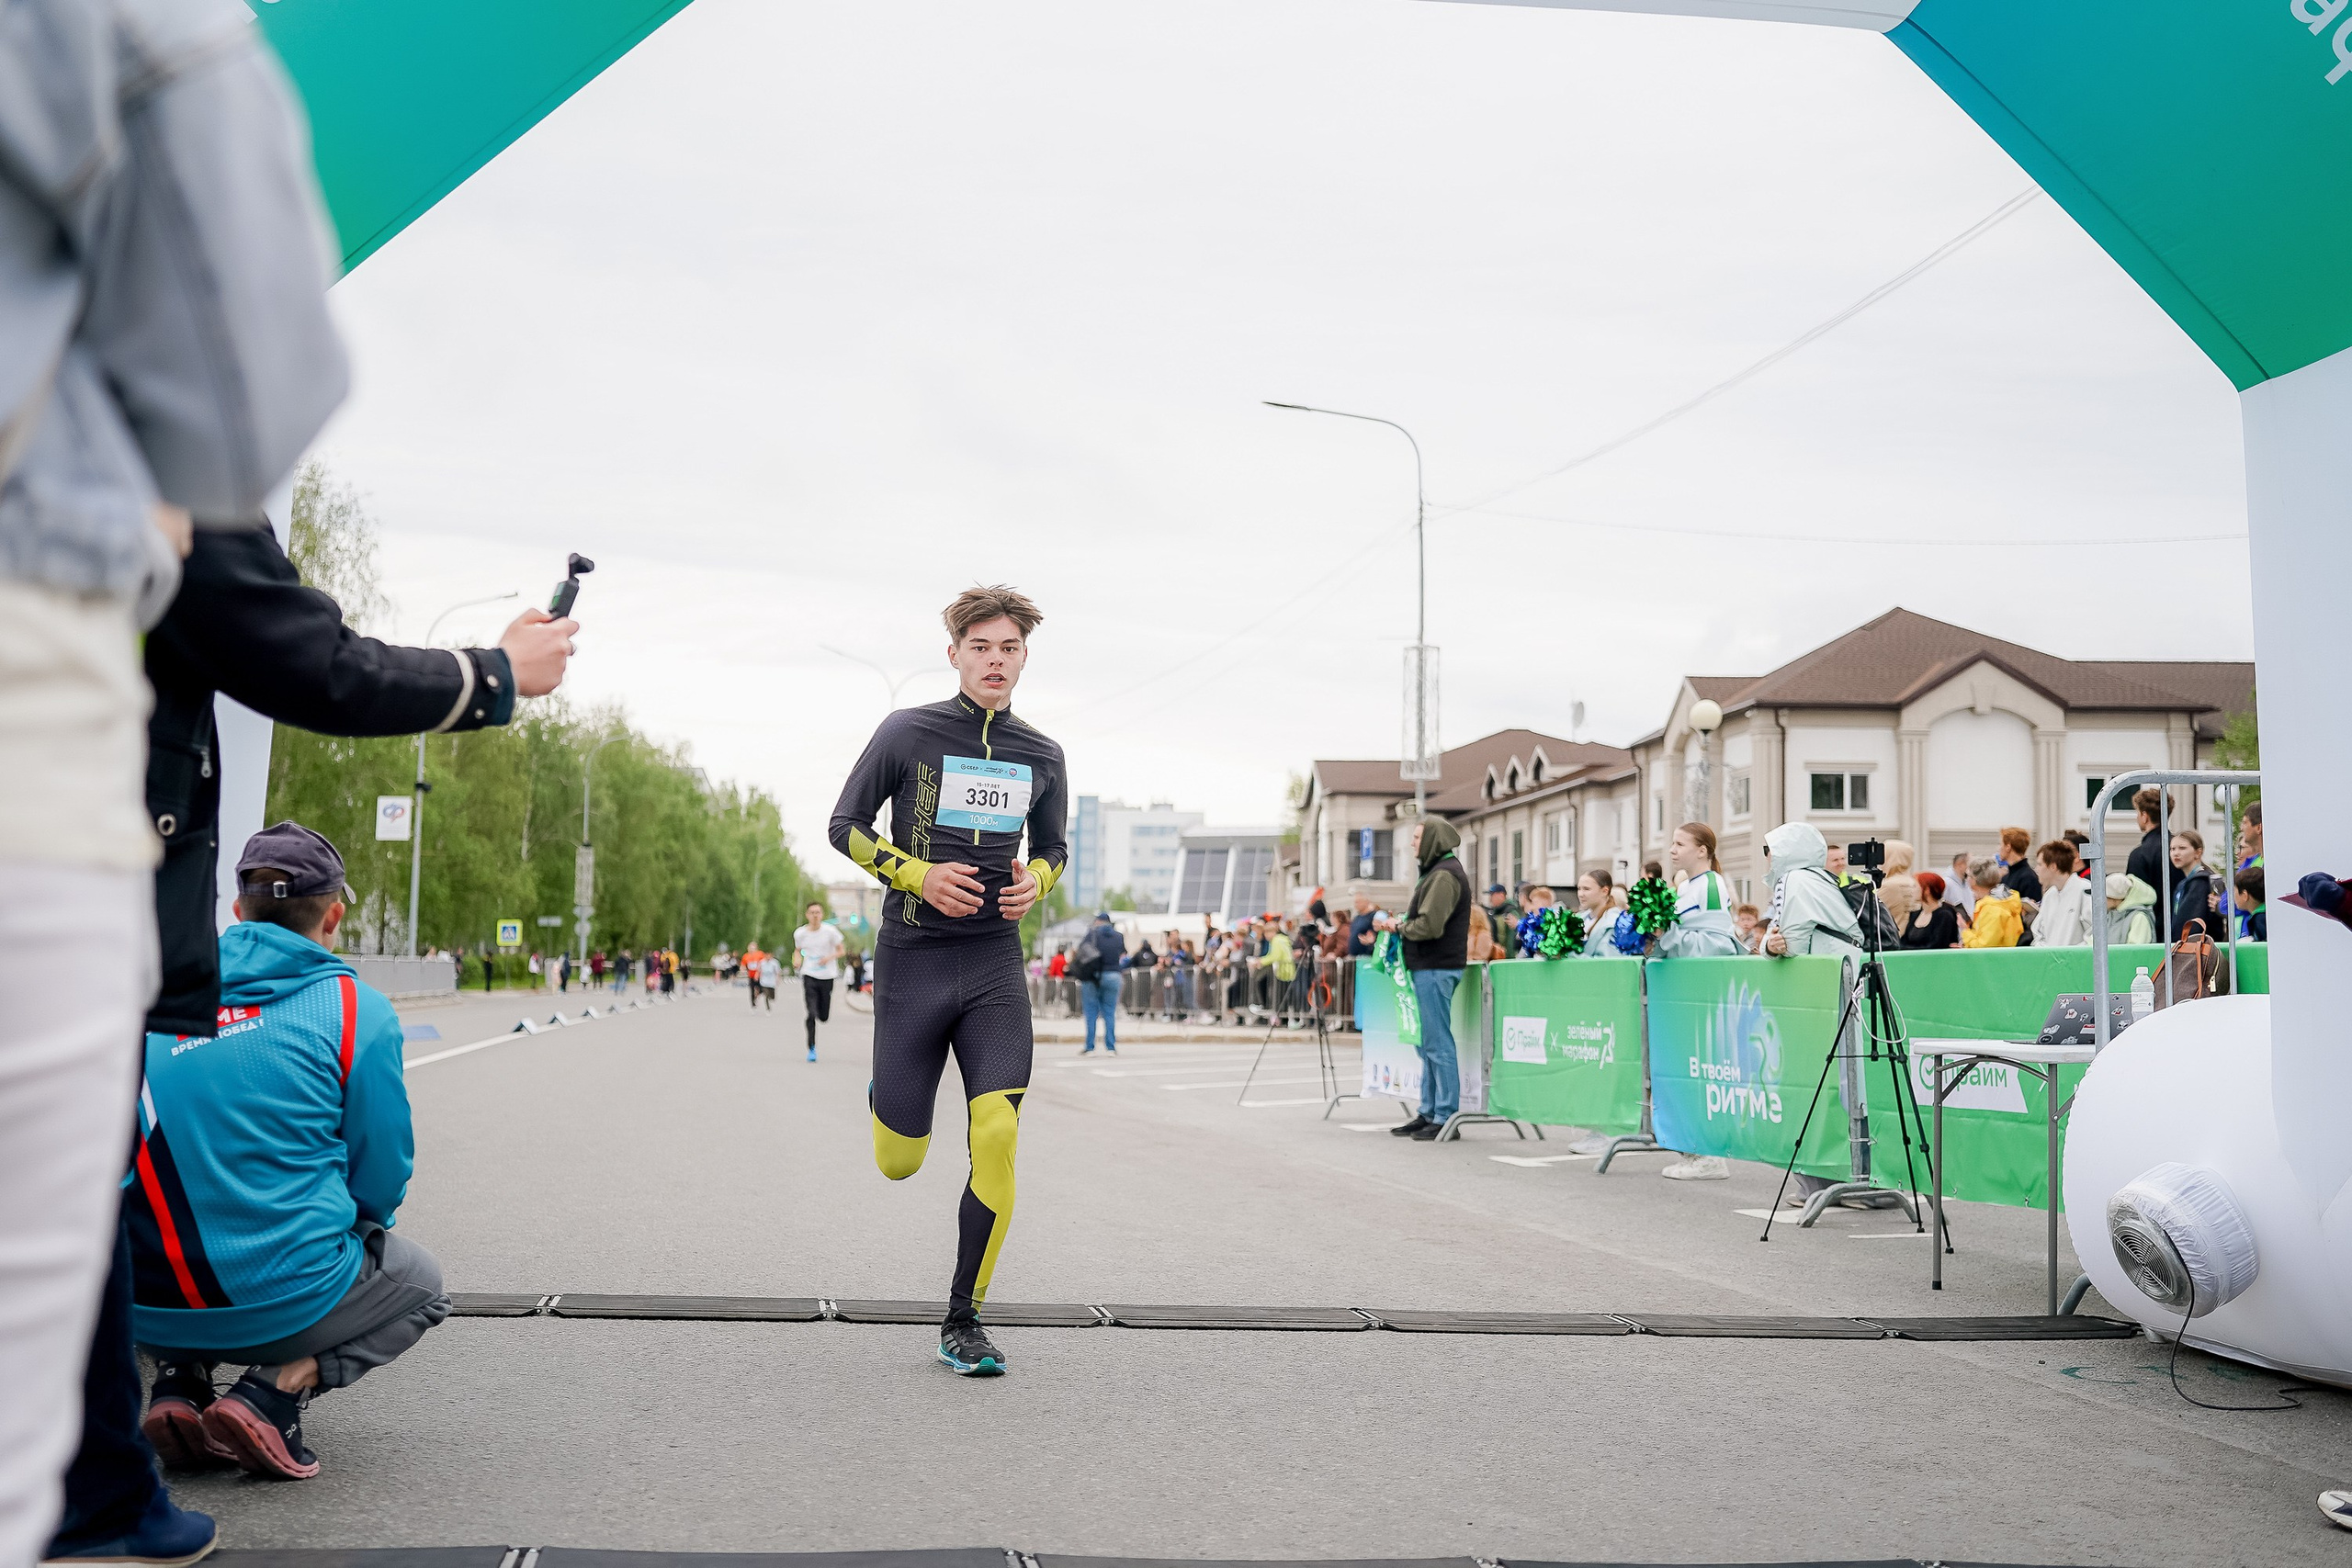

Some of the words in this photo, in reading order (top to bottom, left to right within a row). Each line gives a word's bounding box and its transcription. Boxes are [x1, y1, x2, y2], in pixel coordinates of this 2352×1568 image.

[966, 787, 1009, 809] 3301
[903, 761, 938, 927] FICHER
[1689, 1055, 1700, 1078] В
[1701, 1059, 1741, 1083] твоём
